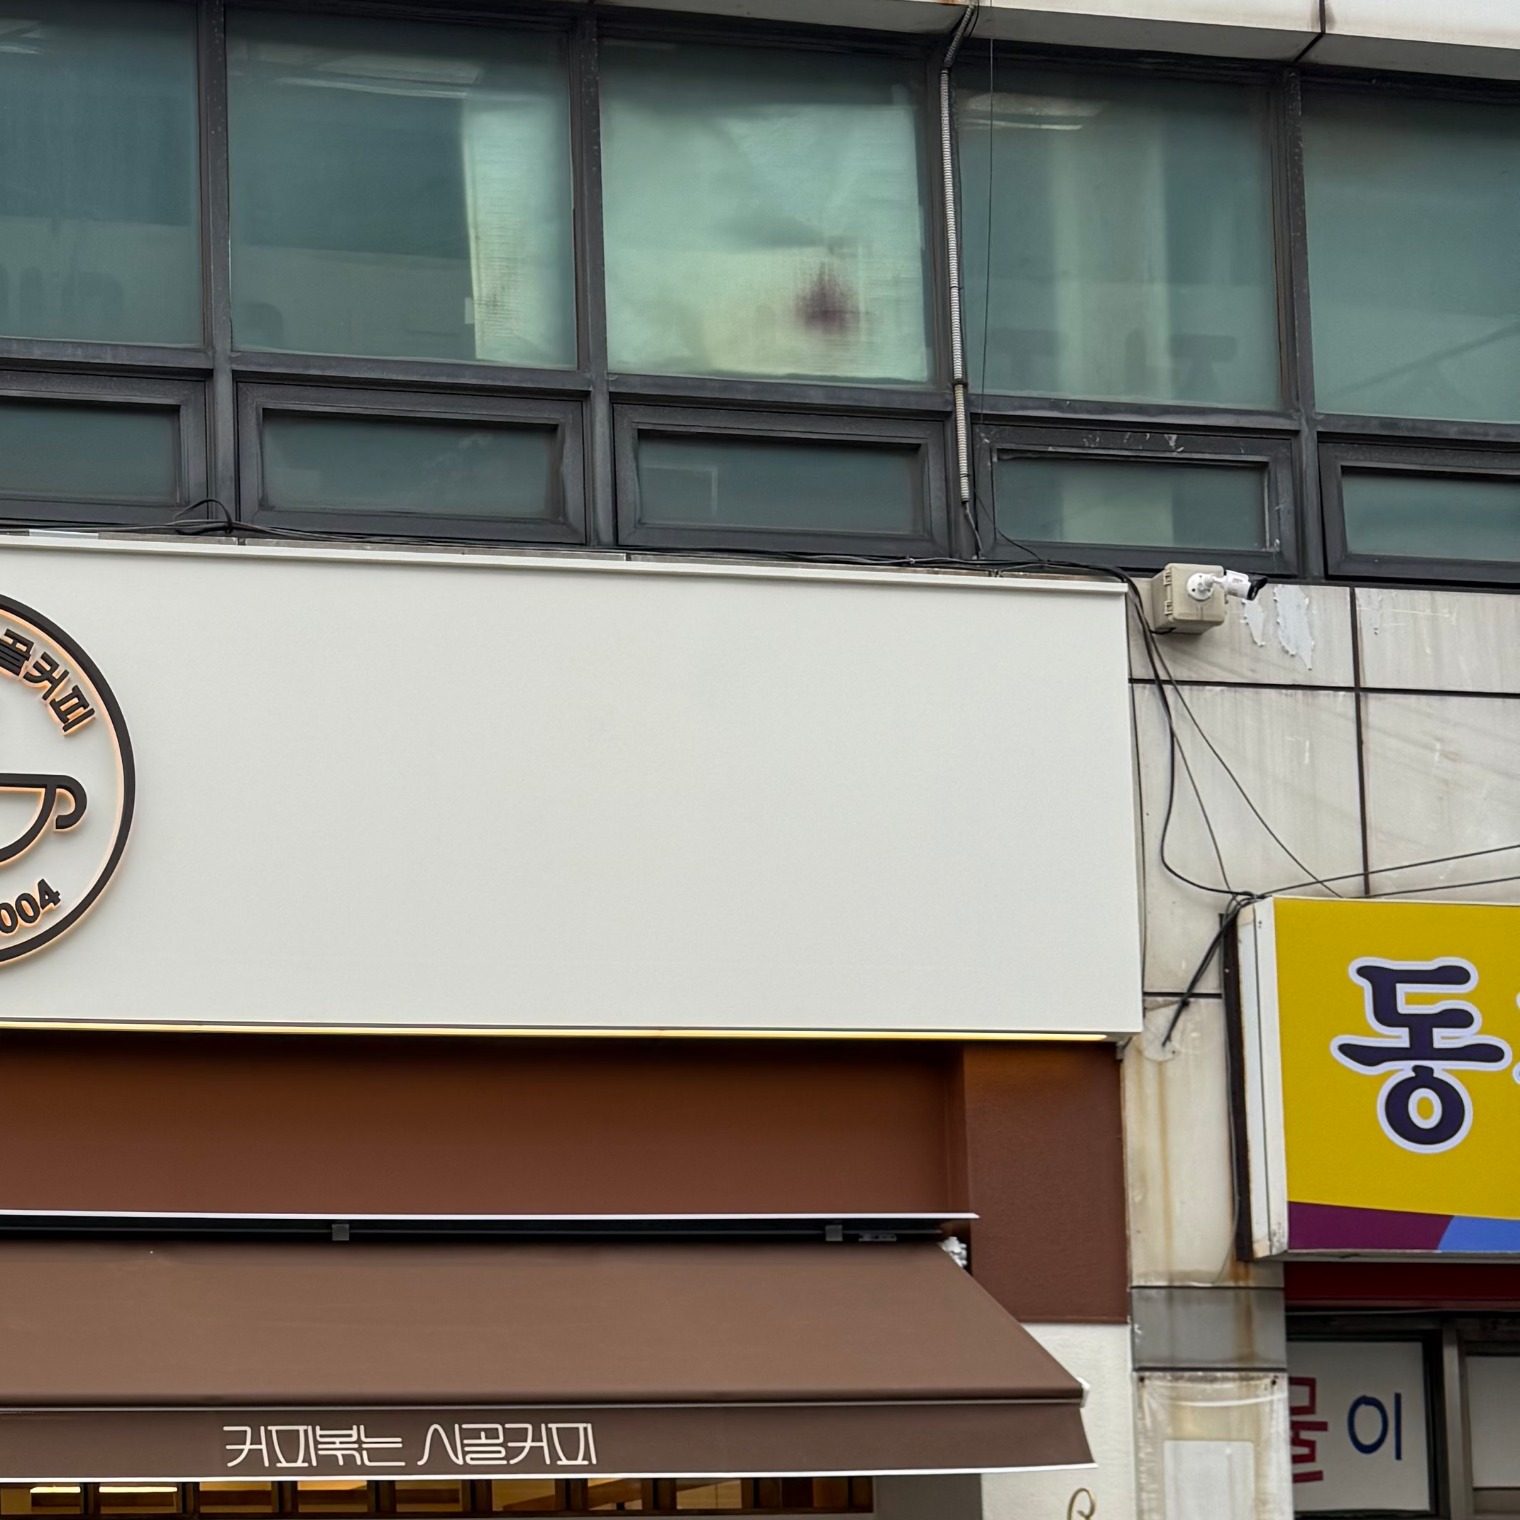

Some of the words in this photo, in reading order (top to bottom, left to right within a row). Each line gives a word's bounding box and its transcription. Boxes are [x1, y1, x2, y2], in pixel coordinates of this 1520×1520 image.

[1330, 957, 1520, 1154] 동
[223, 1424, 406, 1467] 커피볶는
[417, 1423, 598, 1466] 시골커피
